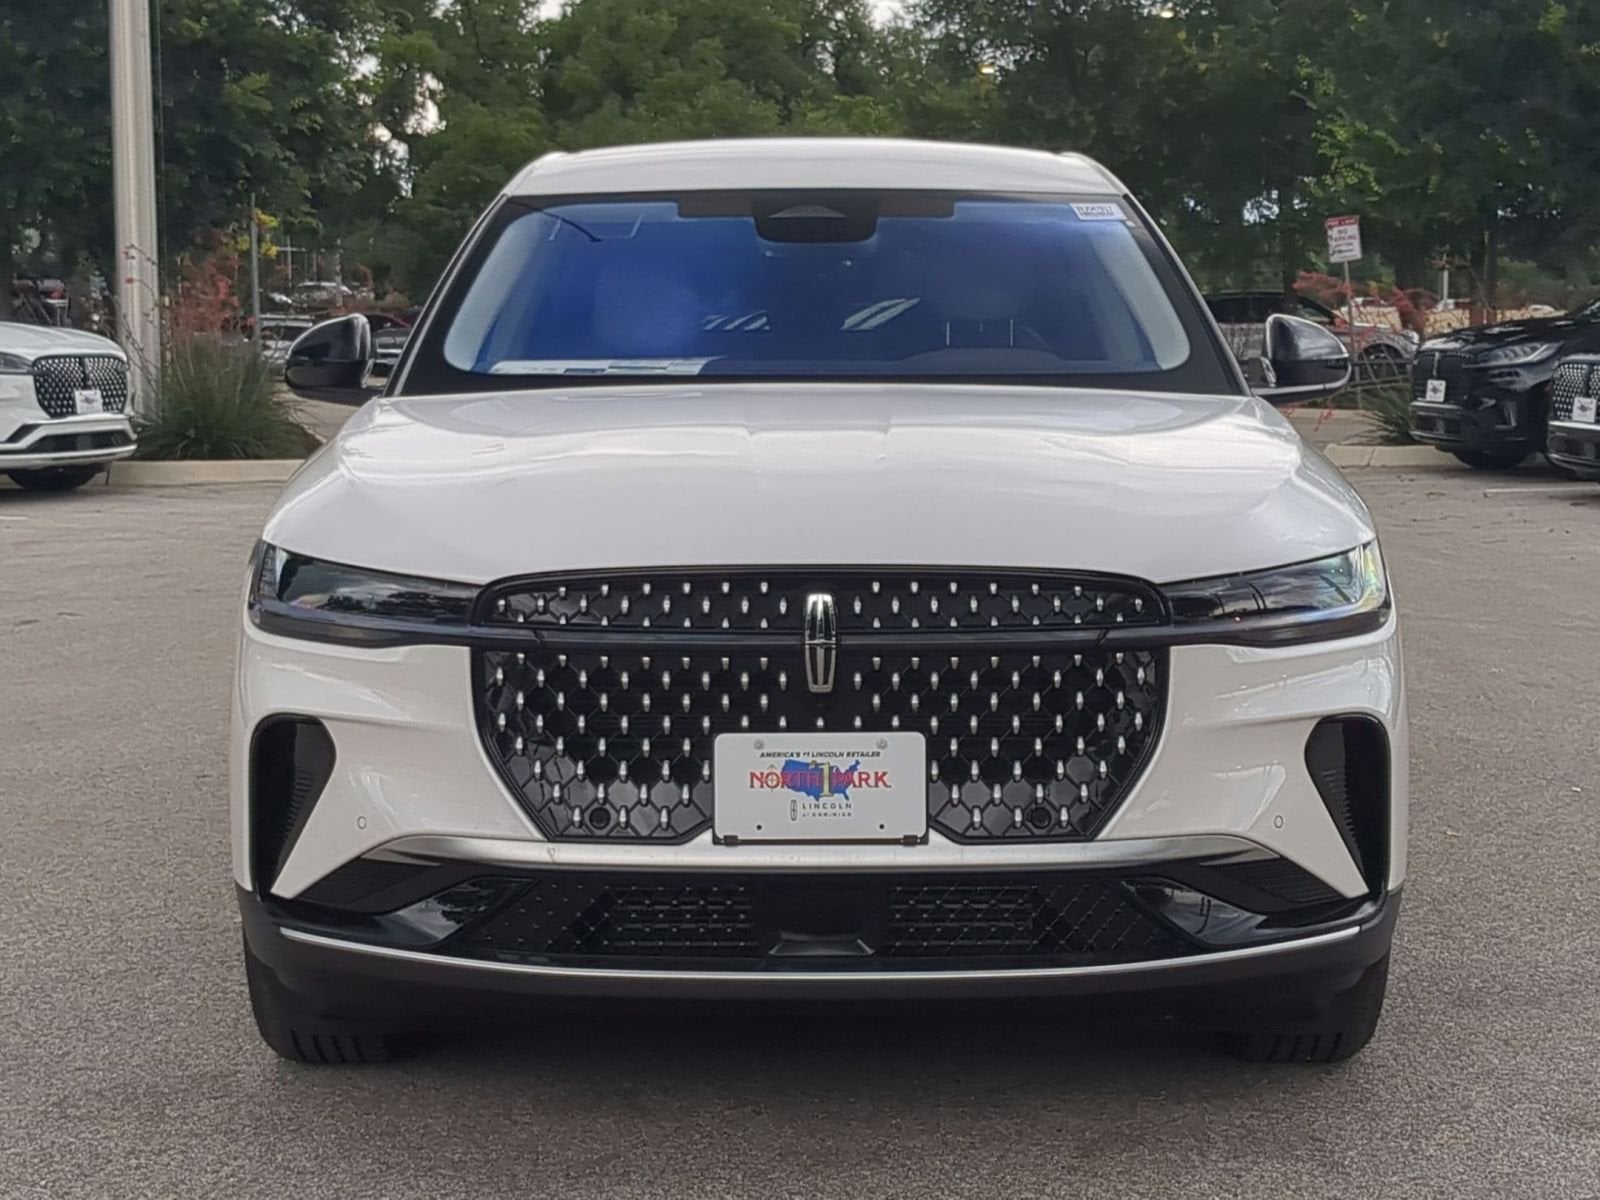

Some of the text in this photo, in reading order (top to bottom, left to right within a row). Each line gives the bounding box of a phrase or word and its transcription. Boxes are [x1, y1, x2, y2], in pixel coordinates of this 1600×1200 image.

[749, 771, 892, 789] NORTH PARK
[802, 802, 852, 810] LINCOLN
